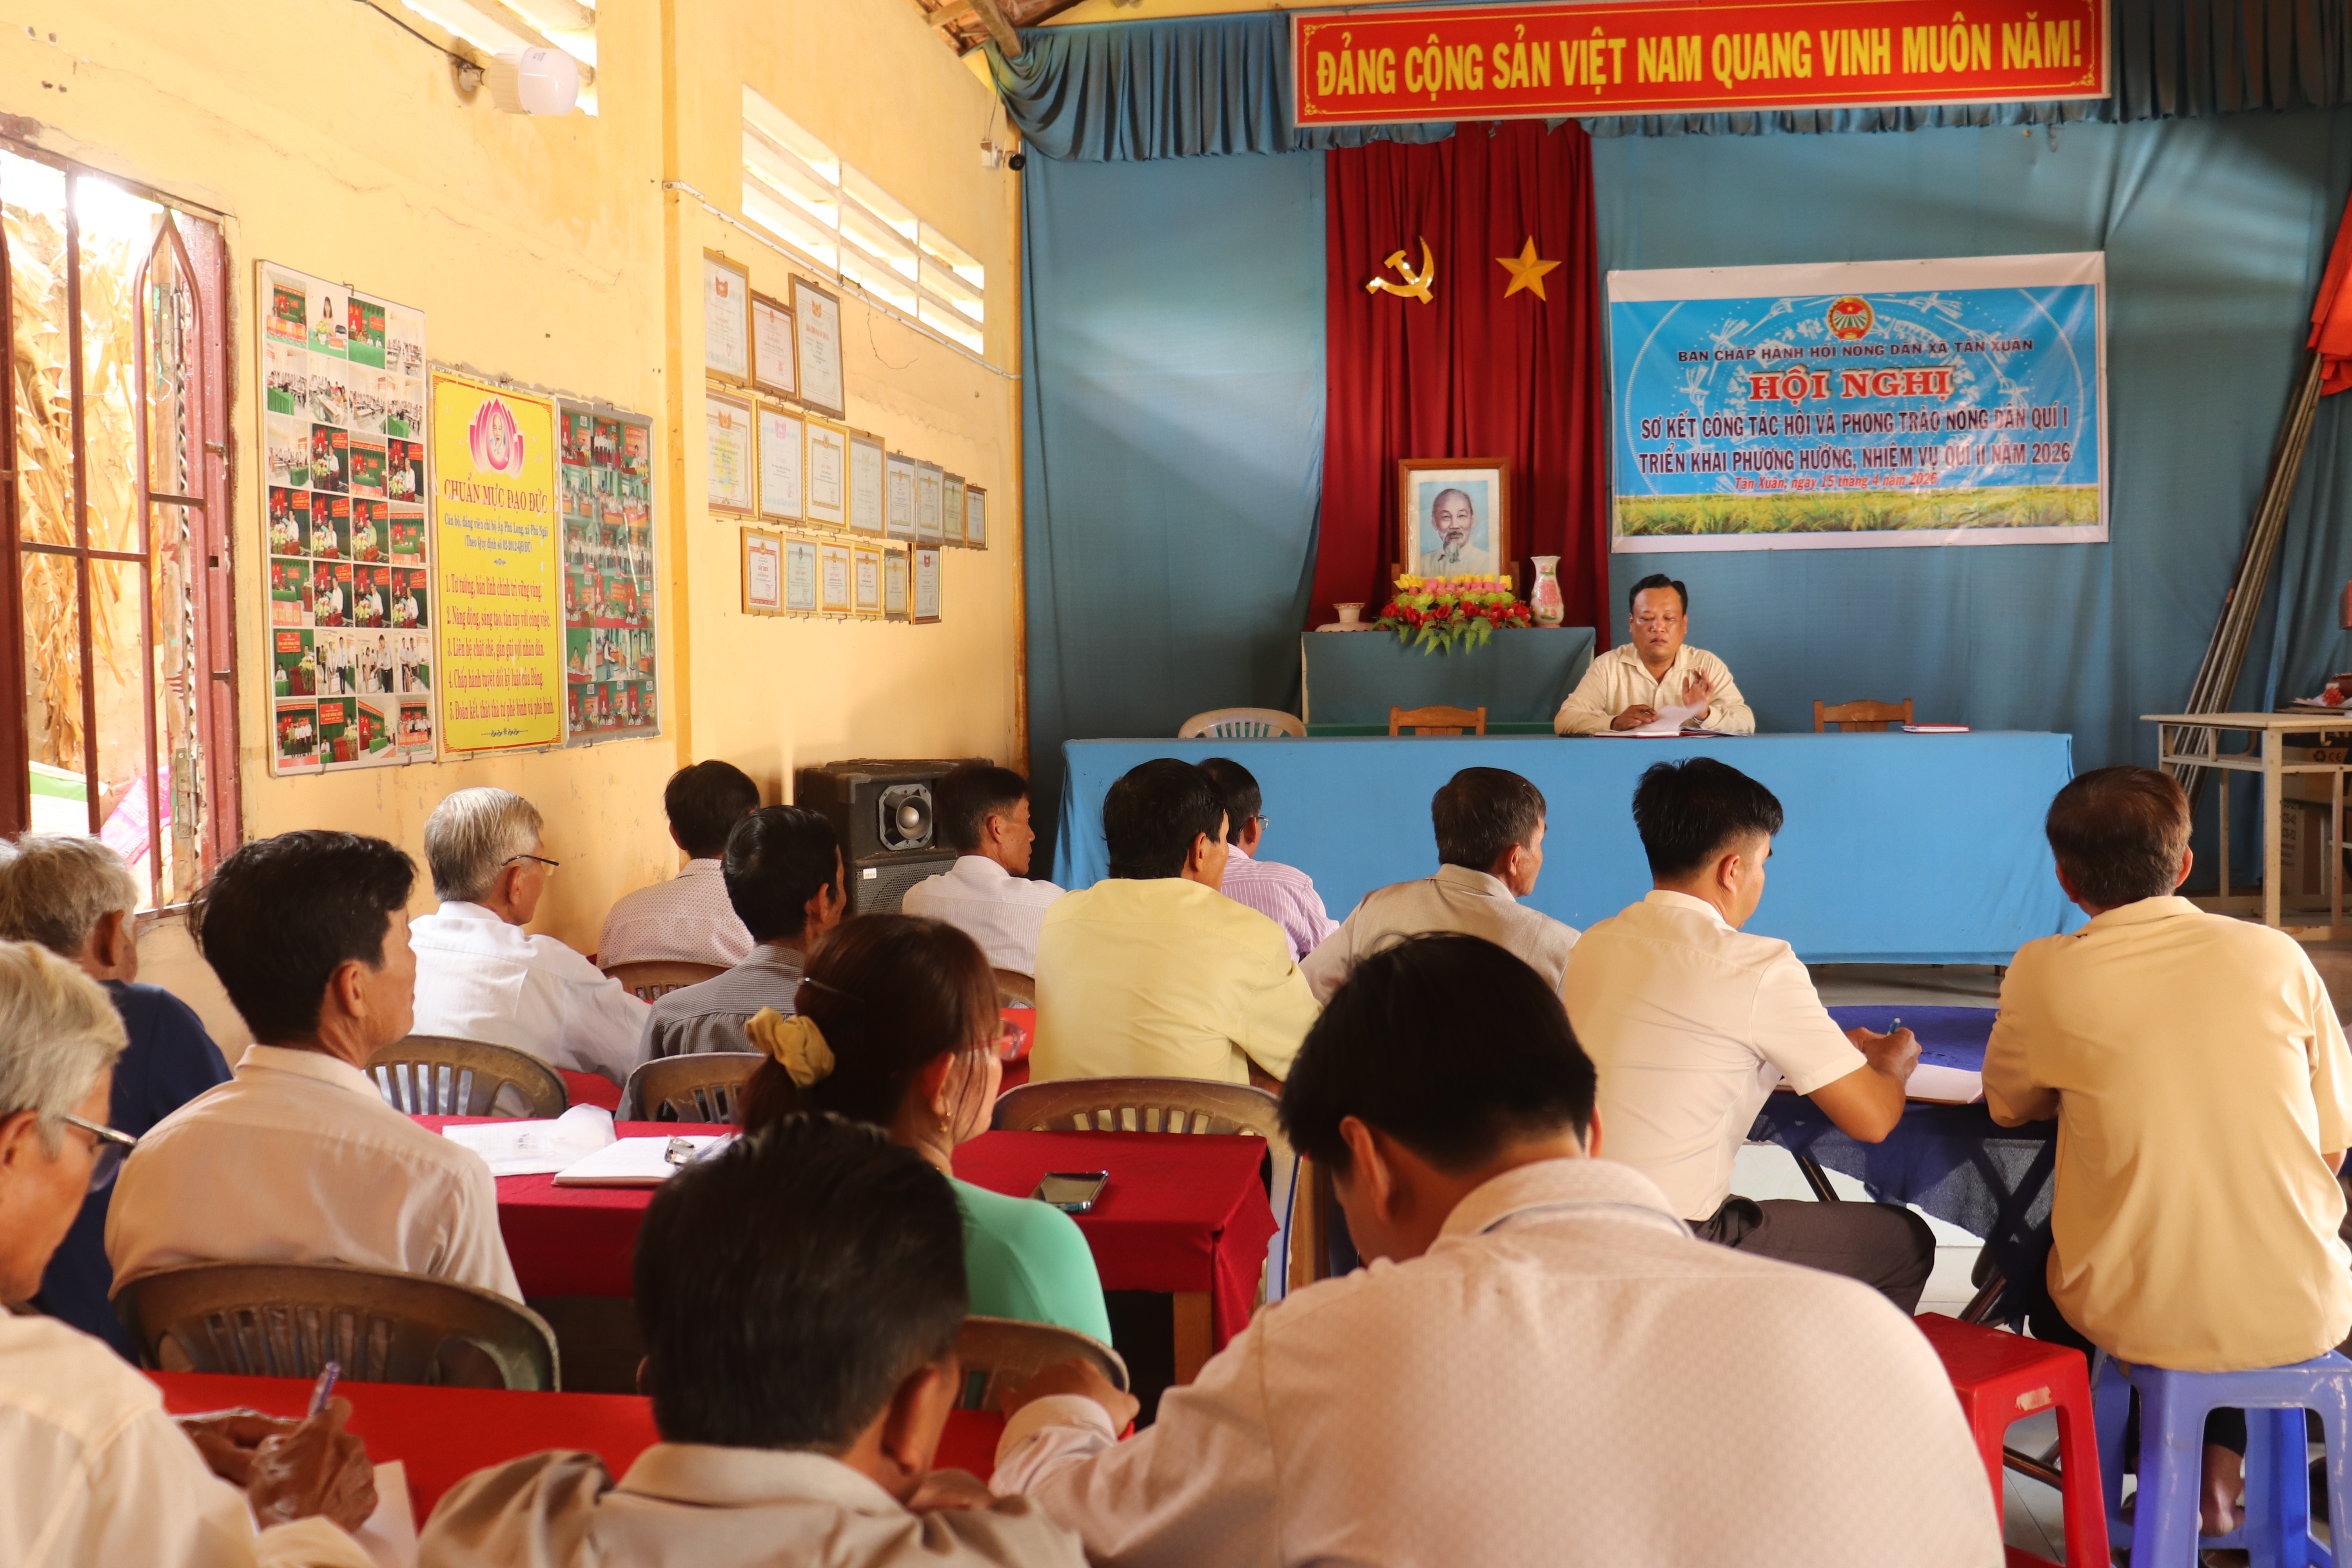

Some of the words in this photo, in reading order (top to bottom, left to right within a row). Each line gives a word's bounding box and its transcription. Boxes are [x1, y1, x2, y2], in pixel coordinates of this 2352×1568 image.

[1317, 32, 1396, 96] ĐẢNG
[1405, 34, 1483, 101] CỘNG
[1492, 24, 1550, 90] SẢN
[1560, 26, 1626, 95] VIỆT
[1637, 35, 1701, 83] NAM
[1711, 30, 1812, 89] QUANG
[1820, 28, 1890, 76] VINH
[1902, 12, 1991, 73] MUÔN
[2002, 12, 2082, 69] NĂM!
[1679, 351, 1708, 362] BAN
[1715, 346, 1756, 361] CHẤP
[1762, 346, 1803, 359] HÀNH
[1810, 344, 1836, 359] HỘI
[1843, 343, 1884, 356] NÔNG
[1891, 341, 1922, 355] DÂN
[1929, 340, 1947, 354] XÃ
[1954, 339, 1985, 353] TÂN
[1991, 337, 2034, 351] XUÂN
[1749, 367, 1829, 405] HỘI
[1841, 367, 1952, 401] NGHỊ
[1641, 415, 1662, 439] SƠ
[1666, 410, 1697, 438] KẾT
[1702, 411, 1743, 438] CÔNG
[1748, 410, 1780, 437] TÁC
[1784, 410, 1810, 440] HỘI
[1816, 408, 1836, 435] VÀ
[1842, 412, 1894, 434] PHONG
[1898, 405, 1941, 432] TRÀO
[1946, 404, 1989, 431] NÔNG
[1994, 403, 2027, 429] DÂN
[2031, 401, 2058, 432] QUÍ
[2063, 406, 2068, 428] I
[1639, 443, 1685, 474] TRIỂN
[1691, 451, 1726, 473] KHAI
[1732, 446, 1795, 472] PHƯƠNG
[1800, 444, 1857, 470] HƯỚNG,
[1862, 442, 1913, 472] NHIỆM
[1918, 445, 1938, 471] VỤ
[1945, 440, 1970, 469] QUÍ
[1975, 444, 1985, 465] II
[1991, 441, 2027, 465] NĂM
[2032, 442, 2071, 465] 2026
[445, 472, 479, 503] CHUẨN
[483, 483, 504, 511] MỰC
[507, 489, 526, 514] ĐẠO
[529, 488, 547, 513] ĐỨC
[1735, 477, 1754, 490] Tân
[1757, 476, 1787, 491] Xuân,
[1791, 476, 1817, 491] ngày
[1821, 475, 1834, 487] 15
[1838, 474, 1868, 489] tháng
[1873, 474, 1879, 486] 4
[1883, 474, 1906, 486] năm
[1909, 472, 1937, 485] 2026
[446, 575, 450, 592] 1.
[451, 574, 458, 592] Tư
[447, 606, 451, 624] 2.
[452, 606, 465, 630] Năng
[448, 638, 452, 656] 3.
[449, 670, 453, 688] 4.
[450, 702, 454, 720] 5.
